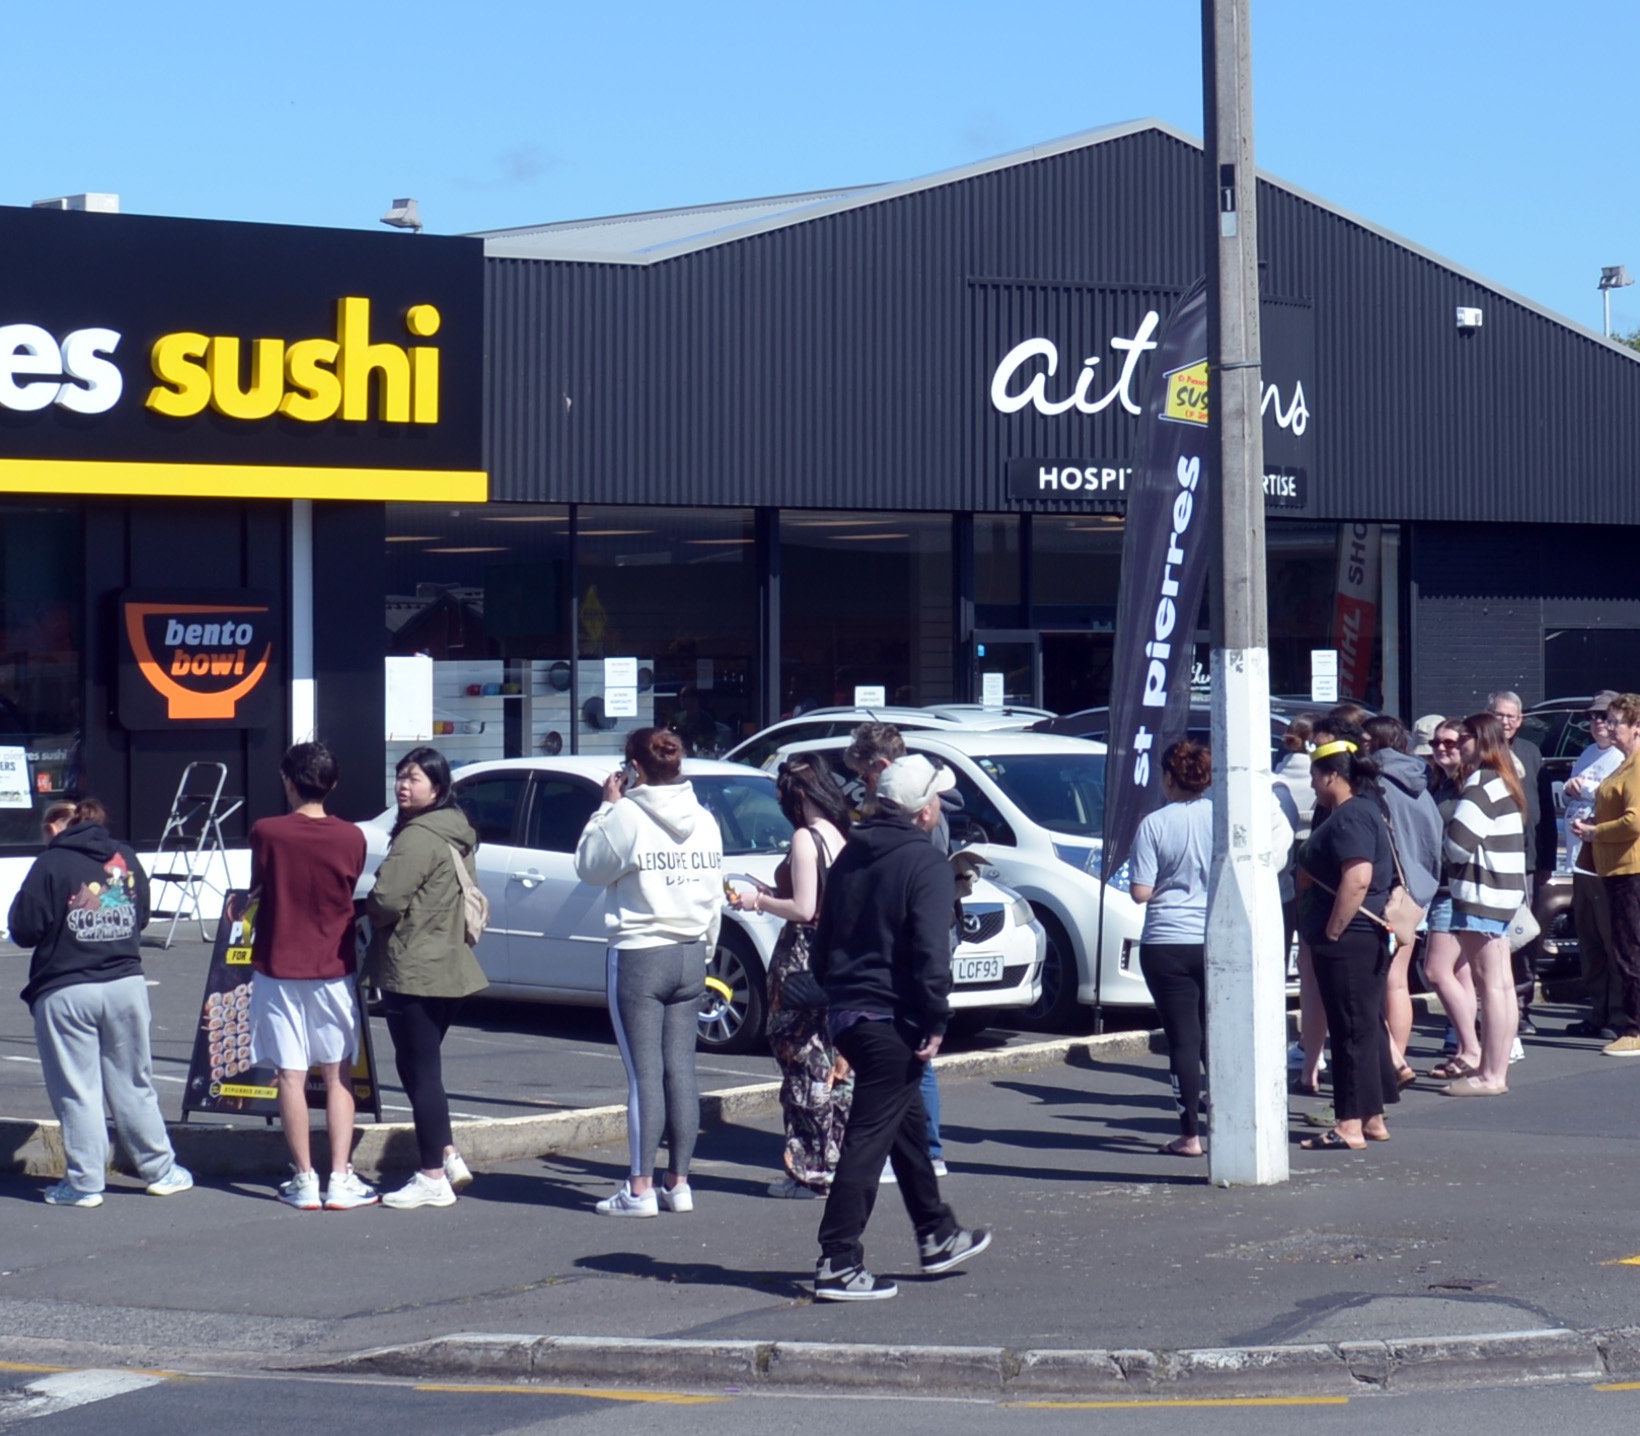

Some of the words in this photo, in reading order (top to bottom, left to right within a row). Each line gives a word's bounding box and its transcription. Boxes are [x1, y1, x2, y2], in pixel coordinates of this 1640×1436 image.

[146, 296, 440, 423] sushi
[1143, 455, 1201, 707] pierres
[165, 619, 253, 646] bento
[1340, 607, 1361, 685] TIHL
[171, 649, 244, 676] bowl
[1134, 726, 1154, 788] st
[637, 851, 688, 871] LEISURE
[231, 950, 247, 961] FOR
